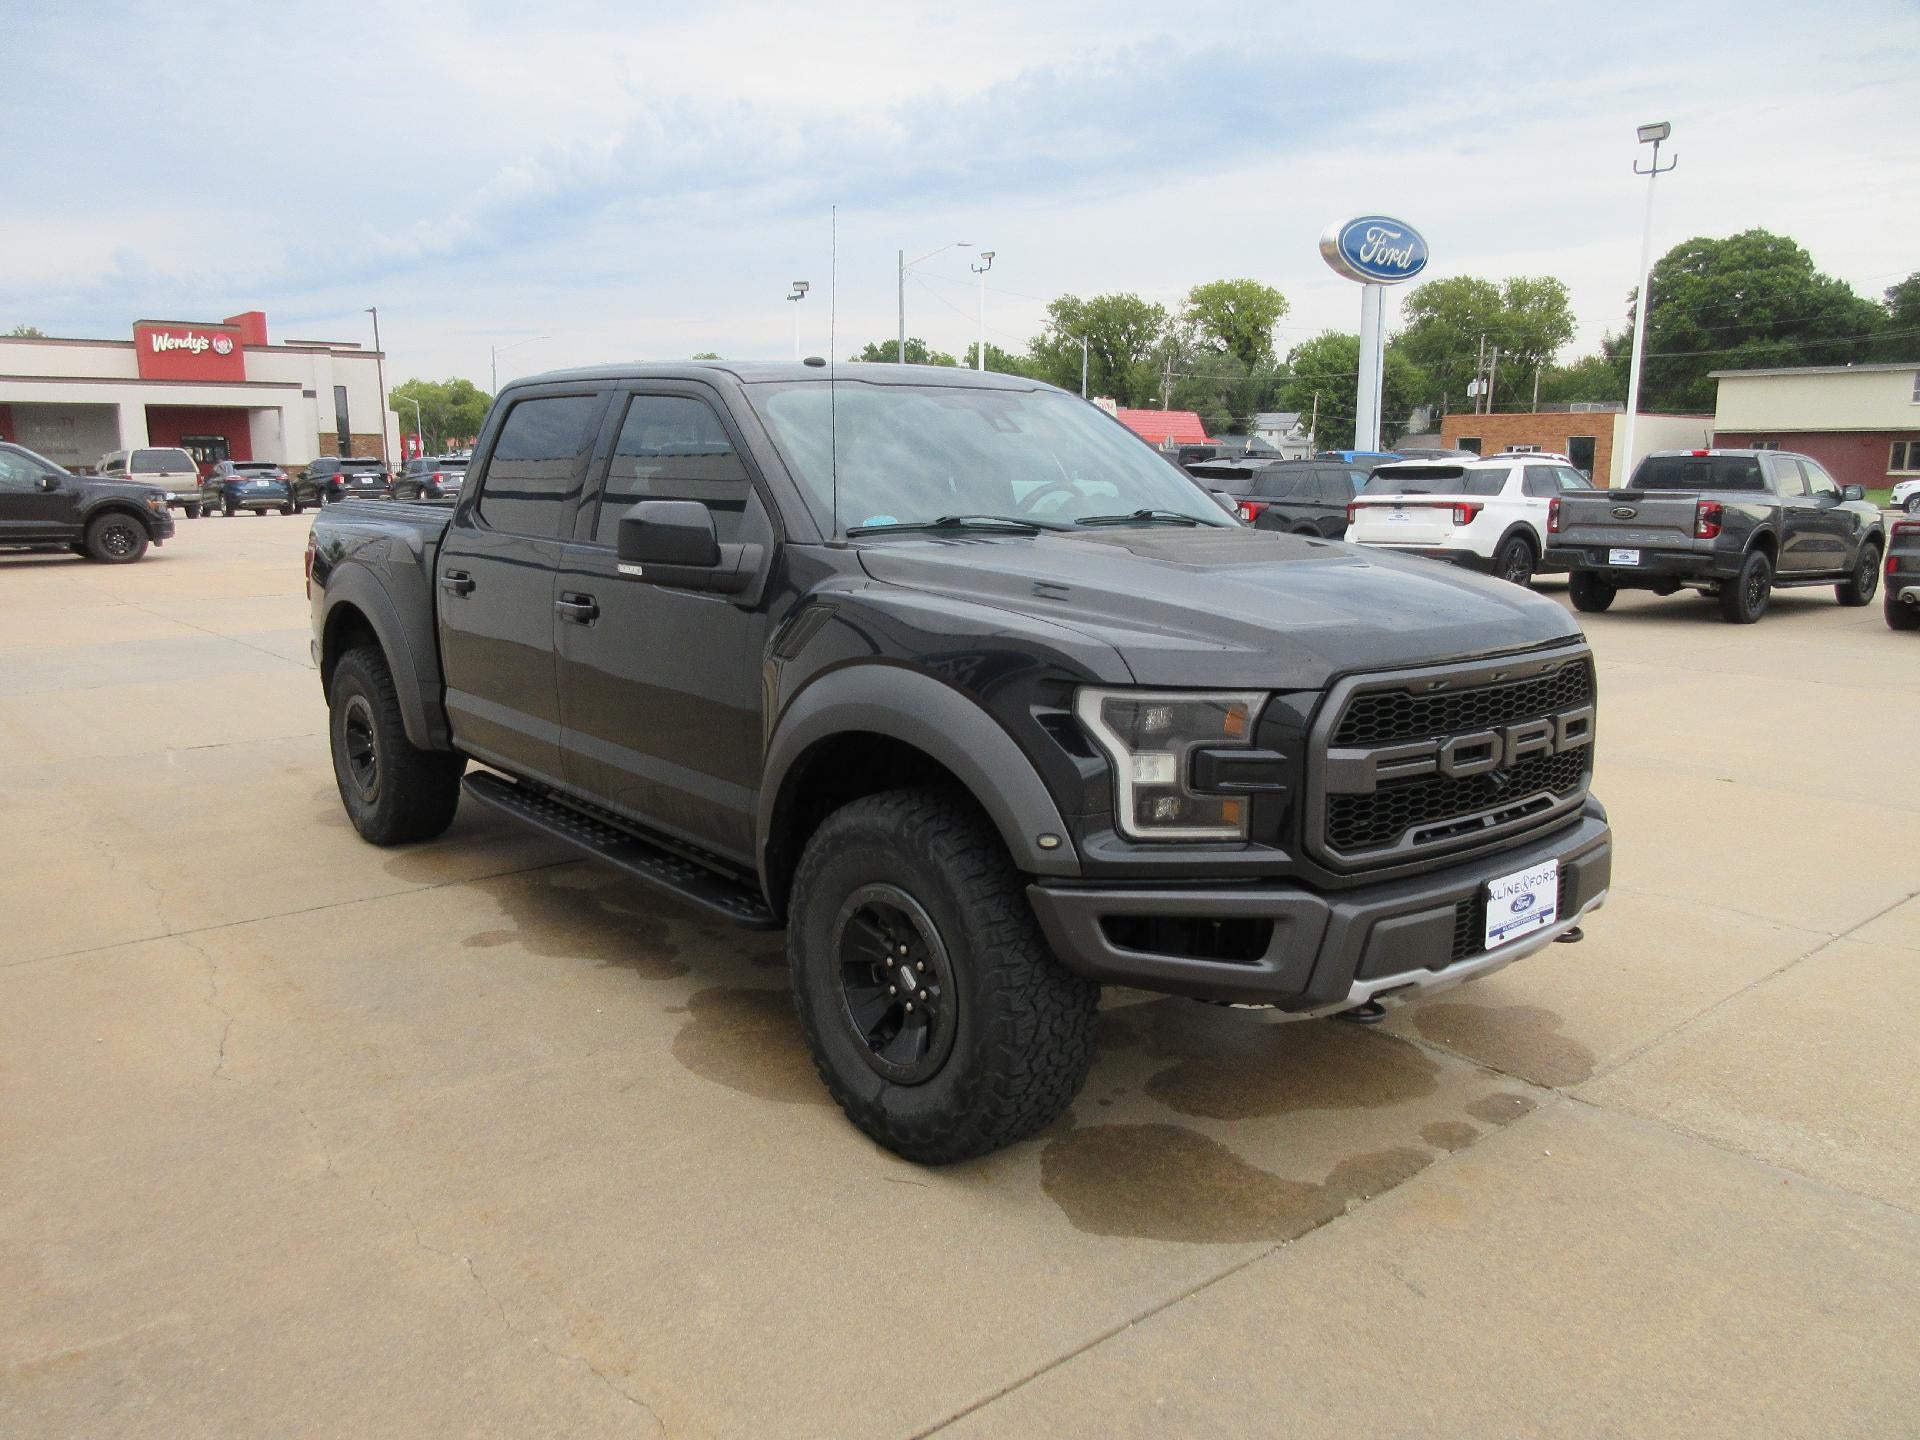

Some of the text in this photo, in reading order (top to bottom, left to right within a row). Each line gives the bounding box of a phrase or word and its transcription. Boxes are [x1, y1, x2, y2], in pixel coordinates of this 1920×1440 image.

[1360, 227, 1413, 269] Ford
[152, 332, 209, 354] Wendy's
[1326, 705, 1593, 794] FORD
[1530, 870, 1555, 888] FORD
